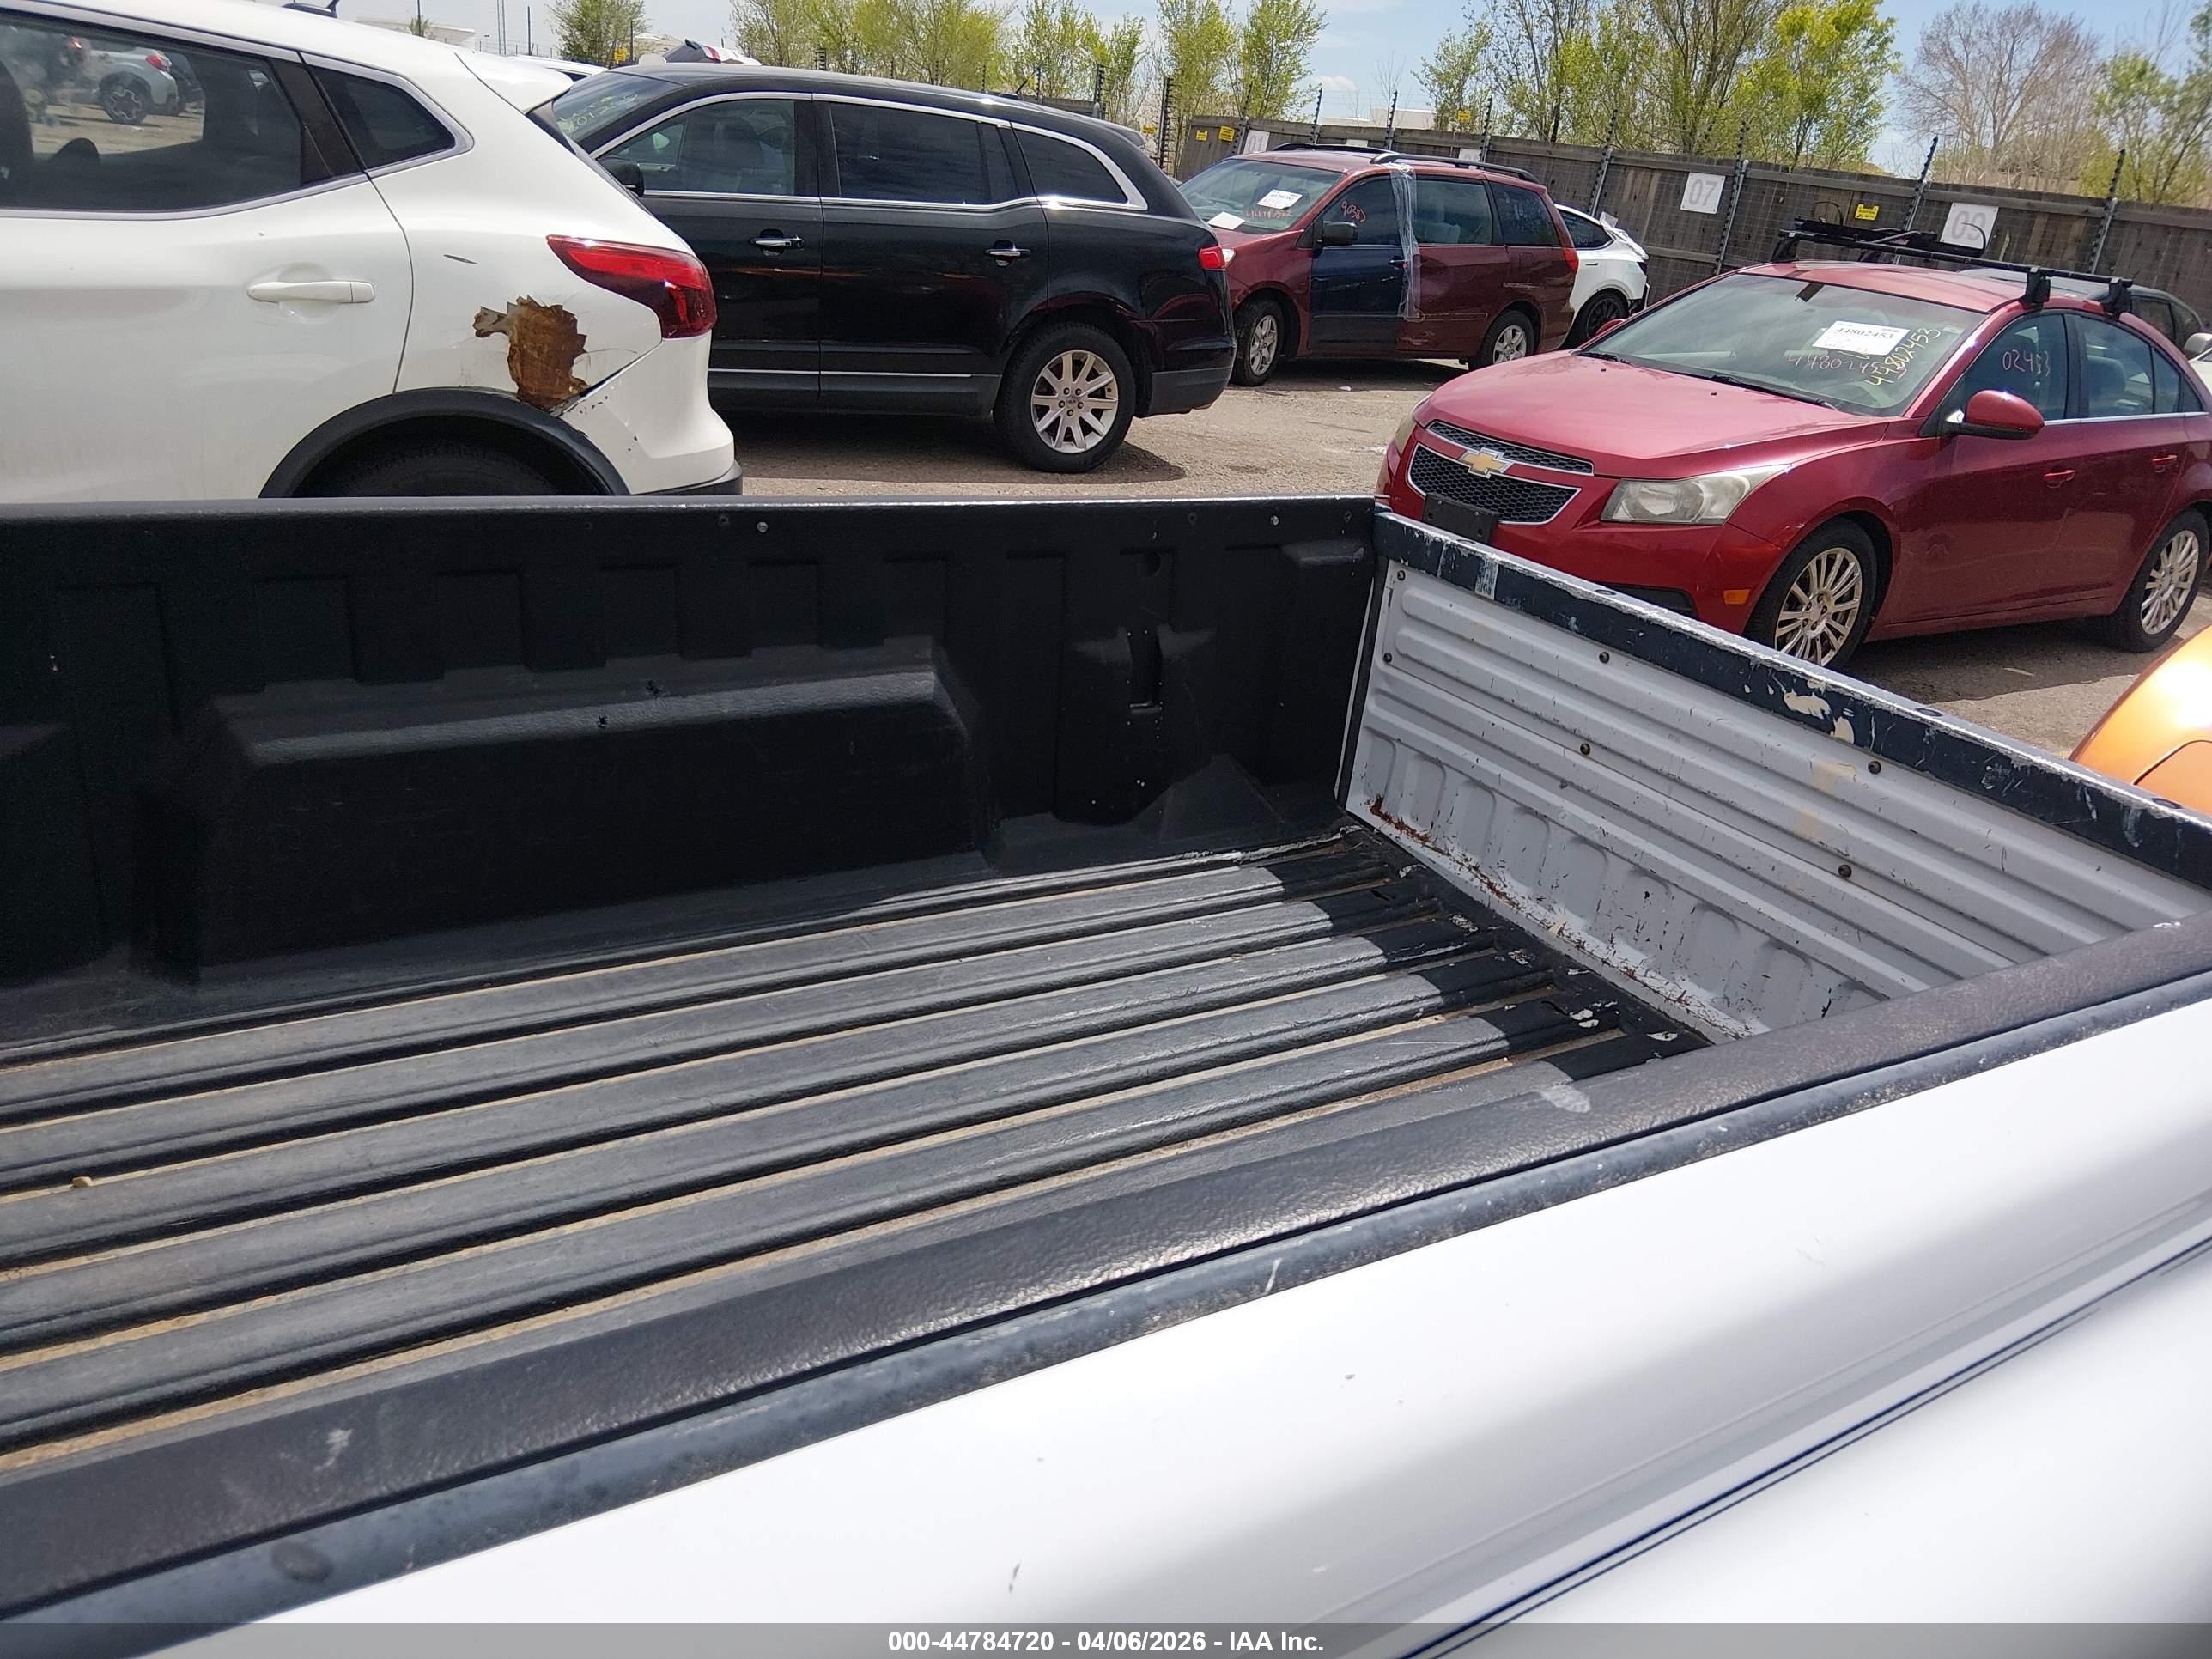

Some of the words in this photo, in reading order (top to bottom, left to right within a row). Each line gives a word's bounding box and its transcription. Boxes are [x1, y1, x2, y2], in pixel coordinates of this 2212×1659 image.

[1688, 179, 1719, 207] 07
[1950, 210, 1986, 241] 09
[1865, 326, 1942, 386] 44802453
